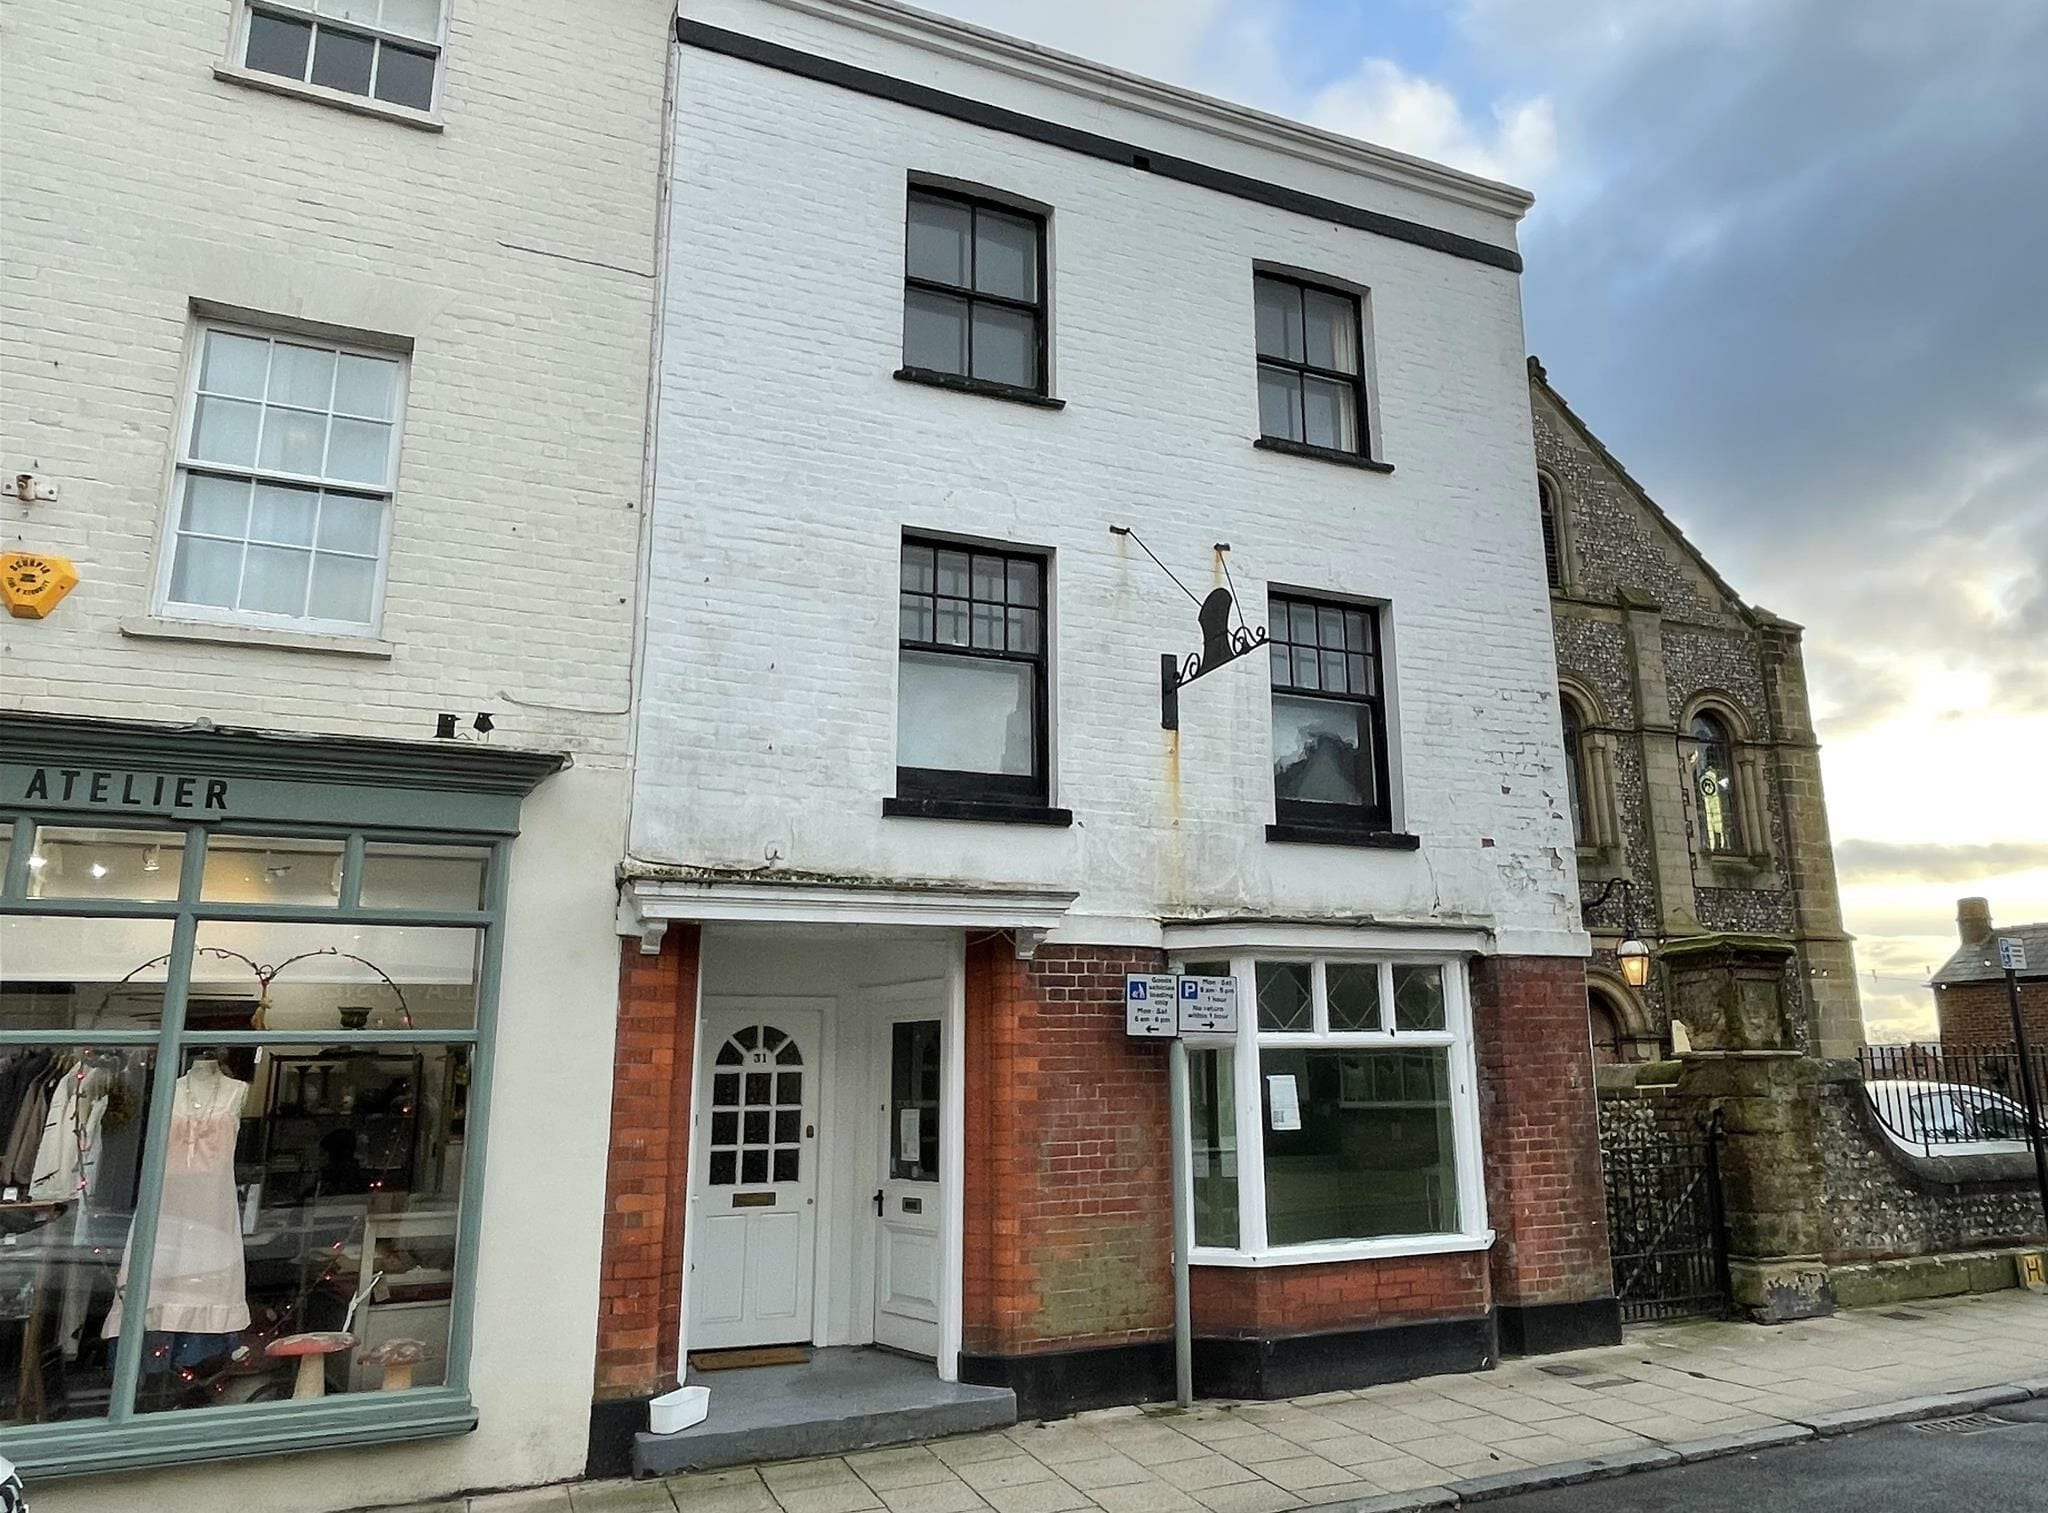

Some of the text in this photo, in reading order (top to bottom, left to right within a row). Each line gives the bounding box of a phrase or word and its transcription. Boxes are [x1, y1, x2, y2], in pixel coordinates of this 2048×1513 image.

[24, 768, 228, 810] ATELIER
[1184, 982, 1196, 997] P
[754, 1053, 766, 1064] 31
[2026, 1257, 2043, 1282] H
